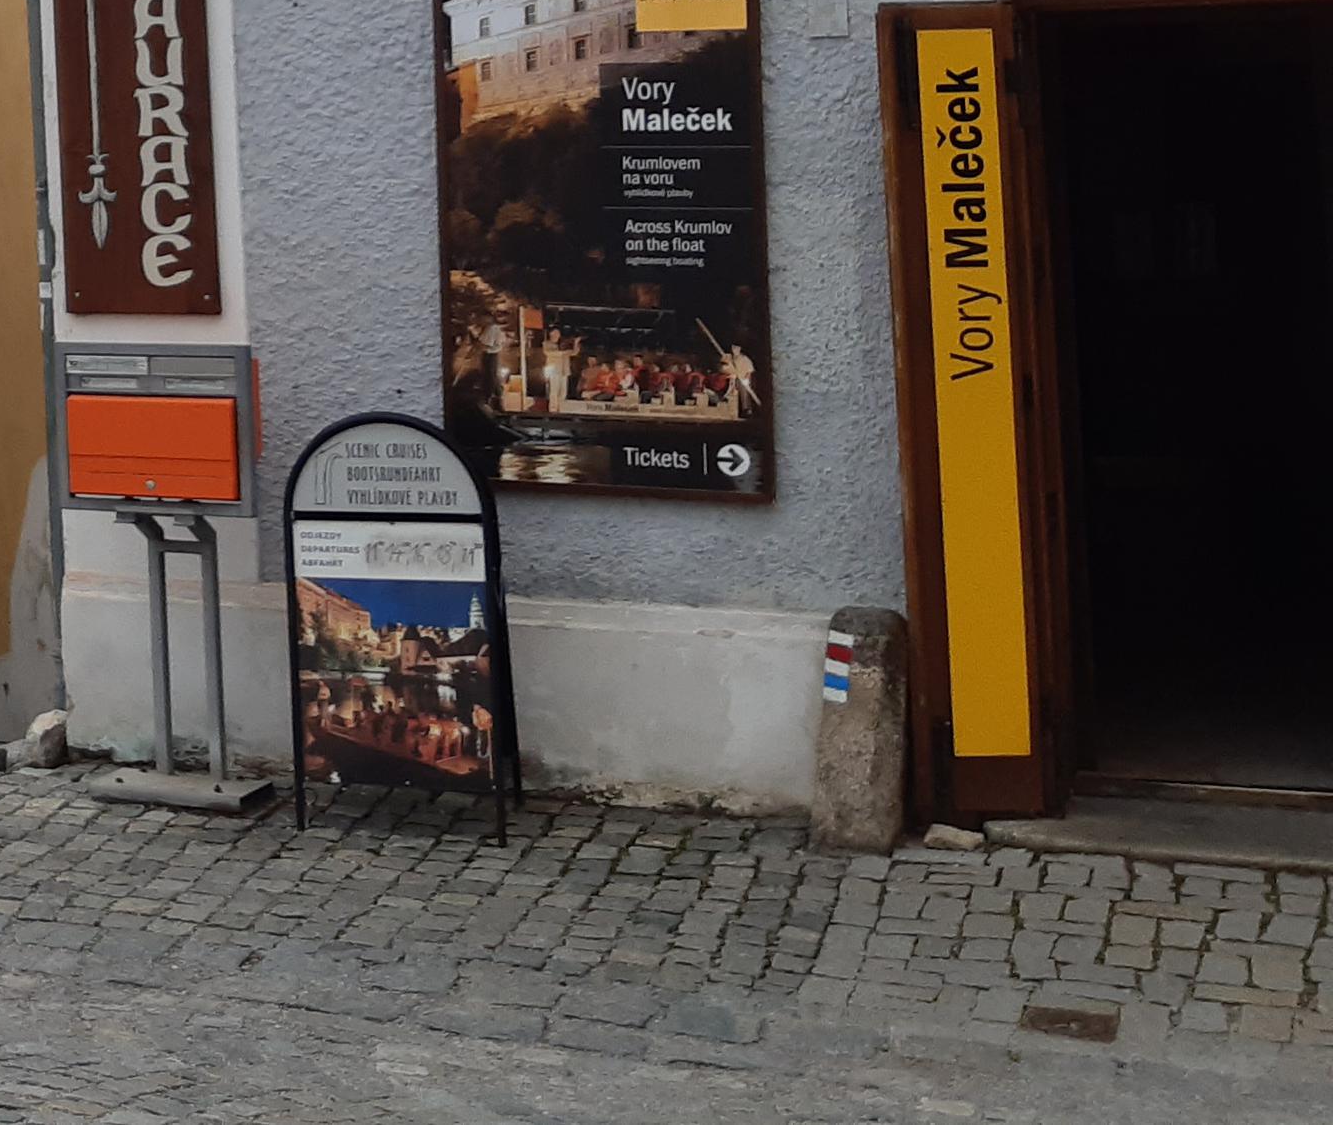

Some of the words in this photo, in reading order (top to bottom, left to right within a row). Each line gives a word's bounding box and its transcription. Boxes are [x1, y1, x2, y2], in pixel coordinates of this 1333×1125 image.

[621, 77, 675, 105] Vory
[621, 106, 733, 132] Maleček
[622, 156, 701, 170] Krumlovem
[935, 66, 990, 269] Maleček
[622, 173, 640, 185] na
[643, 173, 674, 185] voru
[624, 219, 672, 234] Across
[674, 219, 733, 235] Krumlov
[625, 238, 643, 251] on
[646, 237, 670, 251] the
[672, 237, 706, 253] float
[949, 283, 1003, 381] Vory
[345, 442, 381, 459] SCENIC
[386, 442, 428, 460] CRUISES
[622, 446, 691, 469] Tickets
[346, 466, 442, 483] BOOTSRUNDFAHRT
[346, 487, 412, 506] VYHLÍDKOVÉ
[418, 489, 458, 506] PLAVBY
